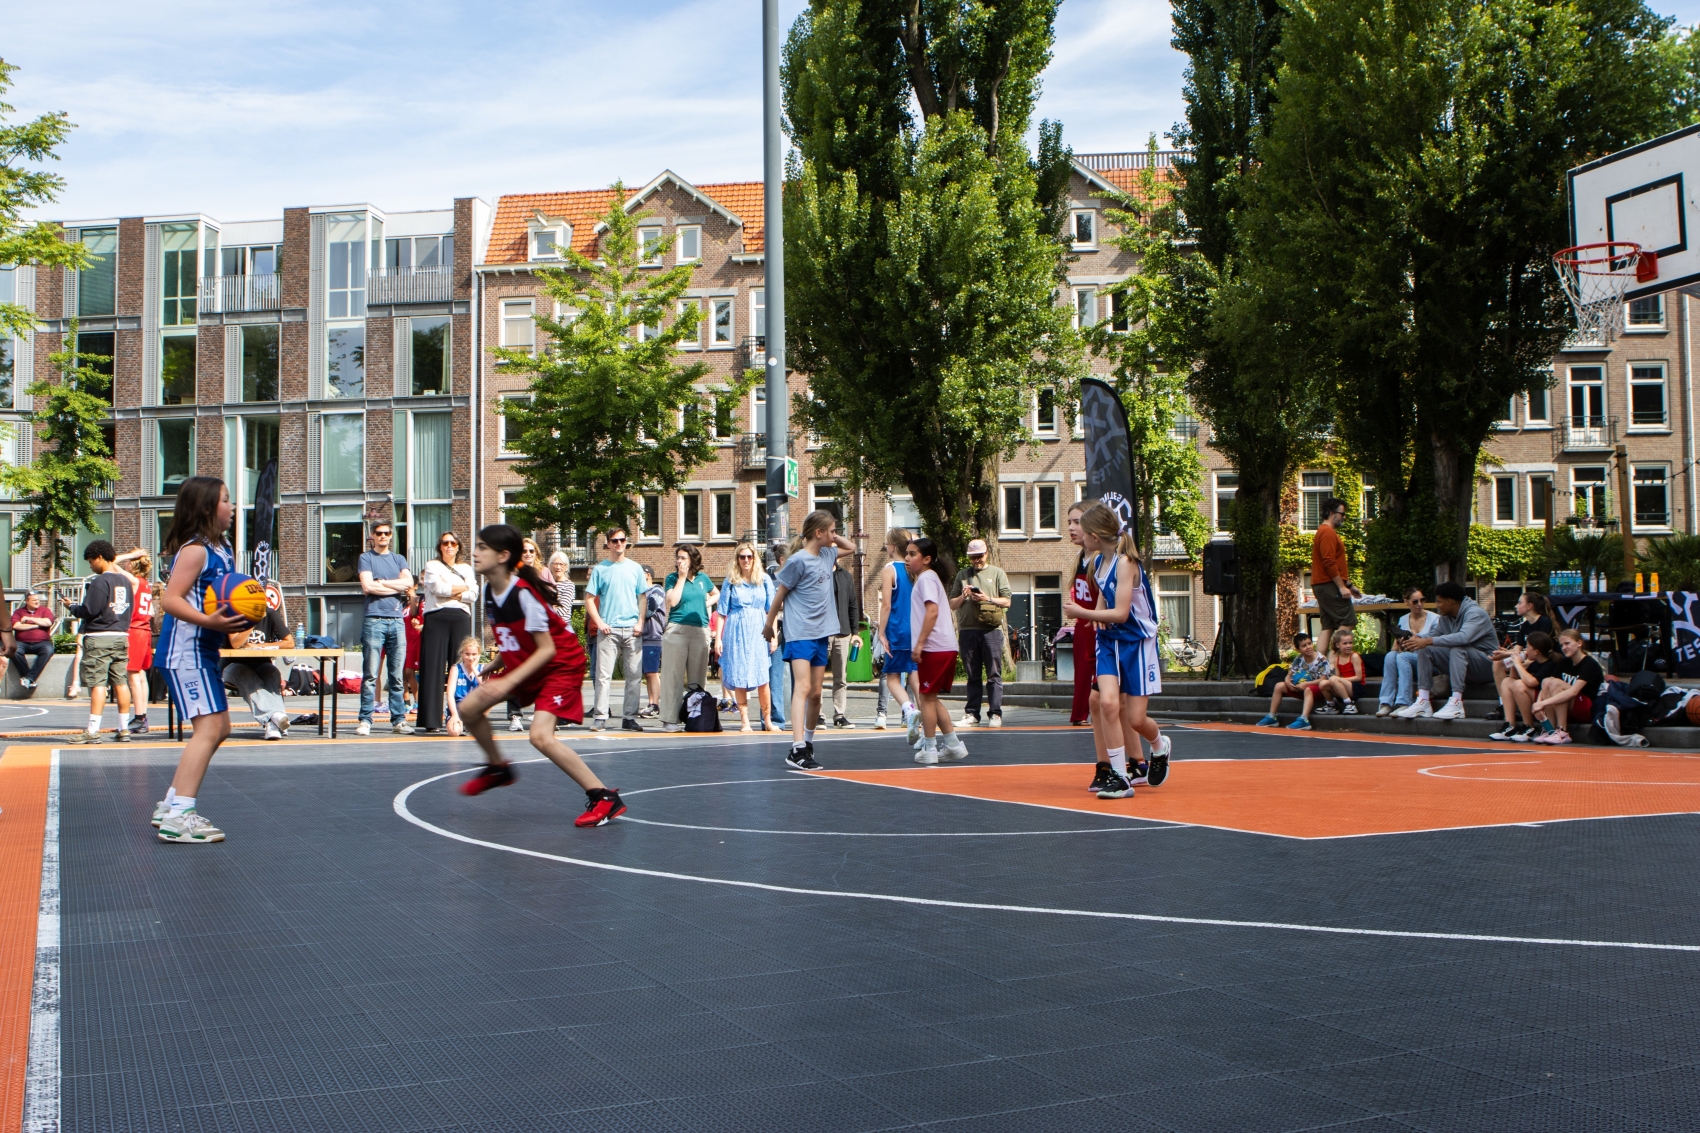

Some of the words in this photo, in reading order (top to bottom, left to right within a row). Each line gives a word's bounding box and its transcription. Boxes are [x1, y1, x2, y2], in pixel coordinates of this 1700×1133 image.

[1148, 670, 1156, 682] 8
[184, 680, 200, 689] KTC
[188, 687, 200, 701] 5
